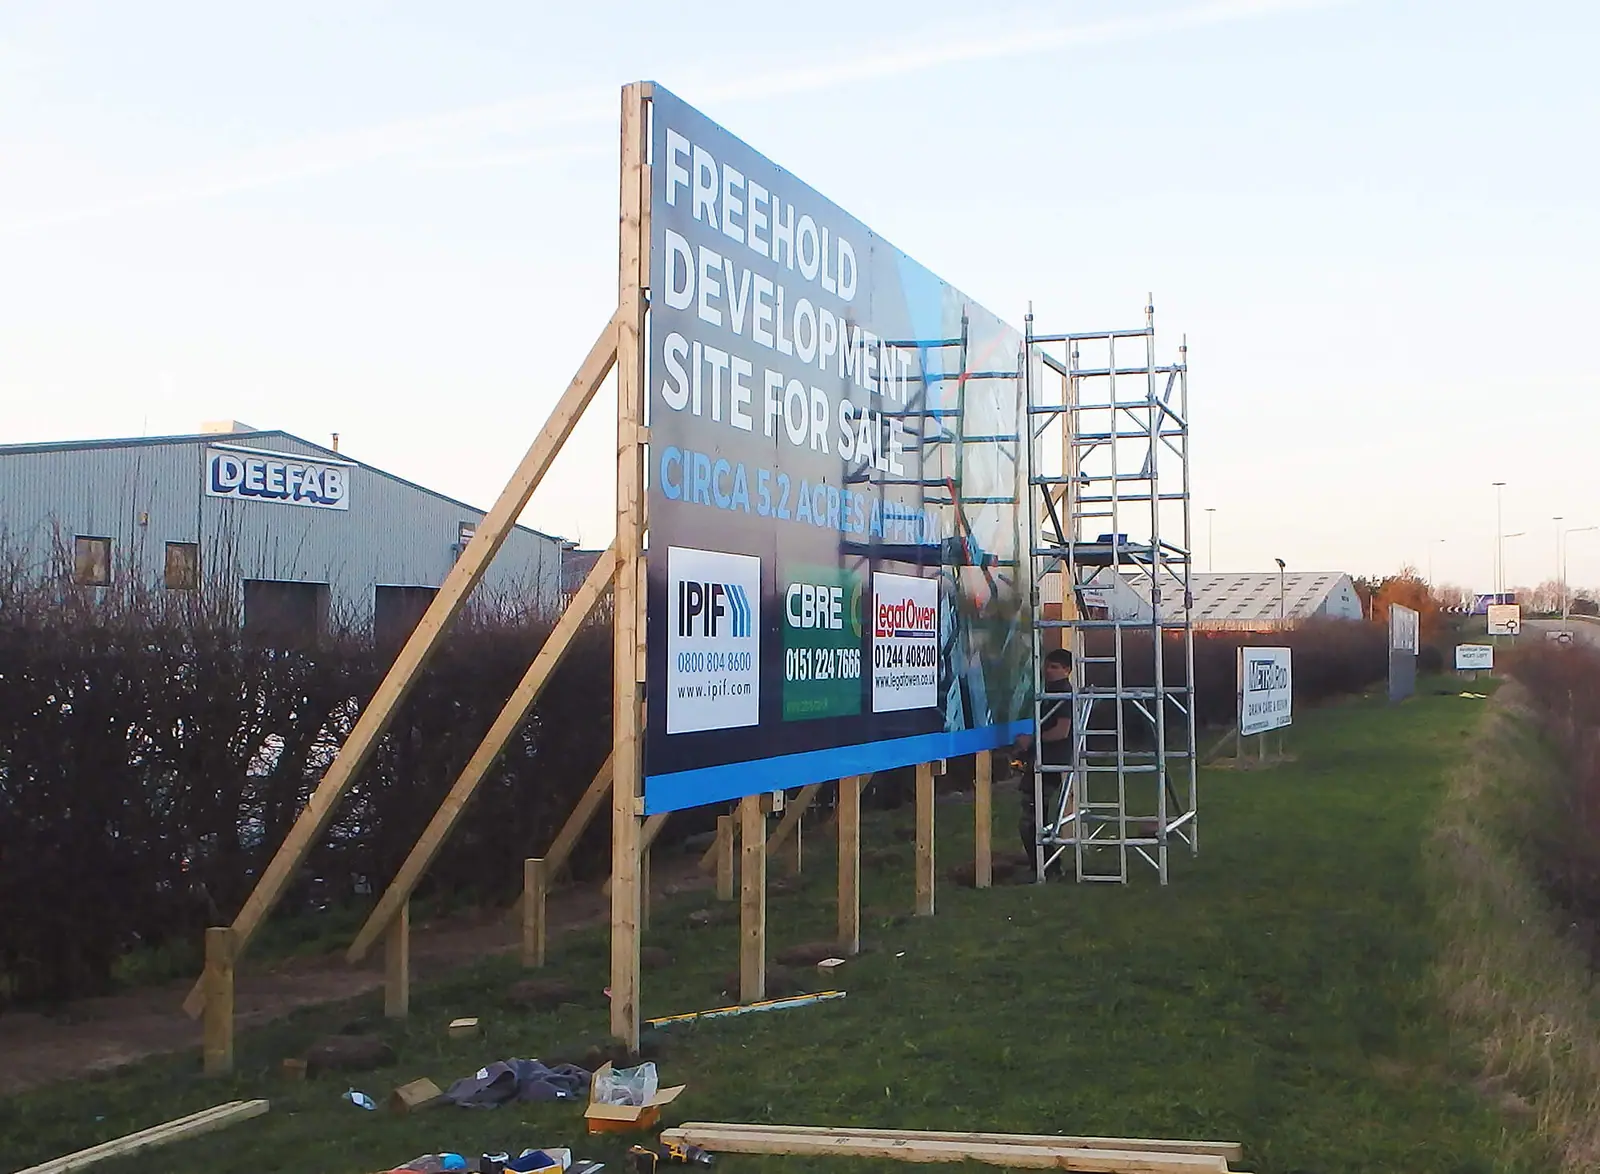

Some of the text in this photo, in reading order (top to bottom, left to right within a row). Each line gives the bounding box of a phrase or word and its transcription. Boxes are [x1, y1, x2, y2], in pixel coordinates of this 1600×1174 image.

[666, 128, 858, 302] FREEHOLD
[664, 228, 912, 405] DEVELOPMENT
[661, 332, 904, 476] SITE FOR SALE
[212, 454, 345, 504] DEEFAB
[660, 446, 749, 514] CIRCA
[757, 468, 791, 520] 5.2
[797, 480, 864, 534] ACRES
[679, 580, 725, 637] IPIF
[786, 583, 843, 629] CBRE
[678, 652, 751, 673] 0800 804 8600
[786, 648, 861, 681] 0151 224 7666
[875, 645, 936, 668] 01244 408200
[678, 679, 751, 701] www.ipif.com
